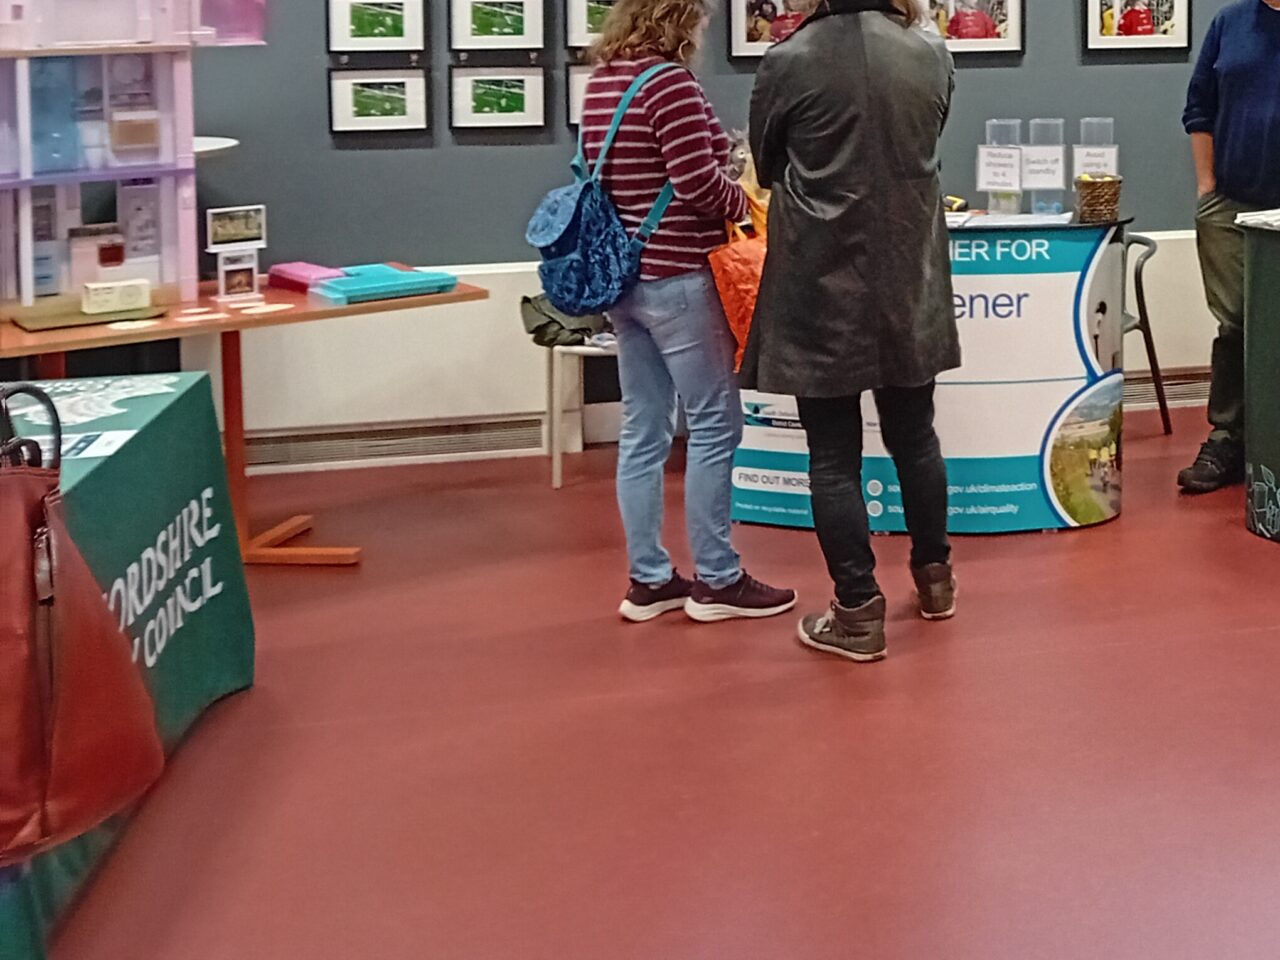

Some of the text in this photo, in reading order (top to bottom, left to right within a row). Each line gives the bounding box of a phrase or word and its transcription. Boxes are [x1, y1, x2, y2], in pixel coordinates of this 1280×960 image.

[949, 239, 1051, 261] ER FOR
[738, 472, 760, 484] FIND
[761, 474, 781, 486] OUT
[102, 486, 221, 632] ORDSHIRE
